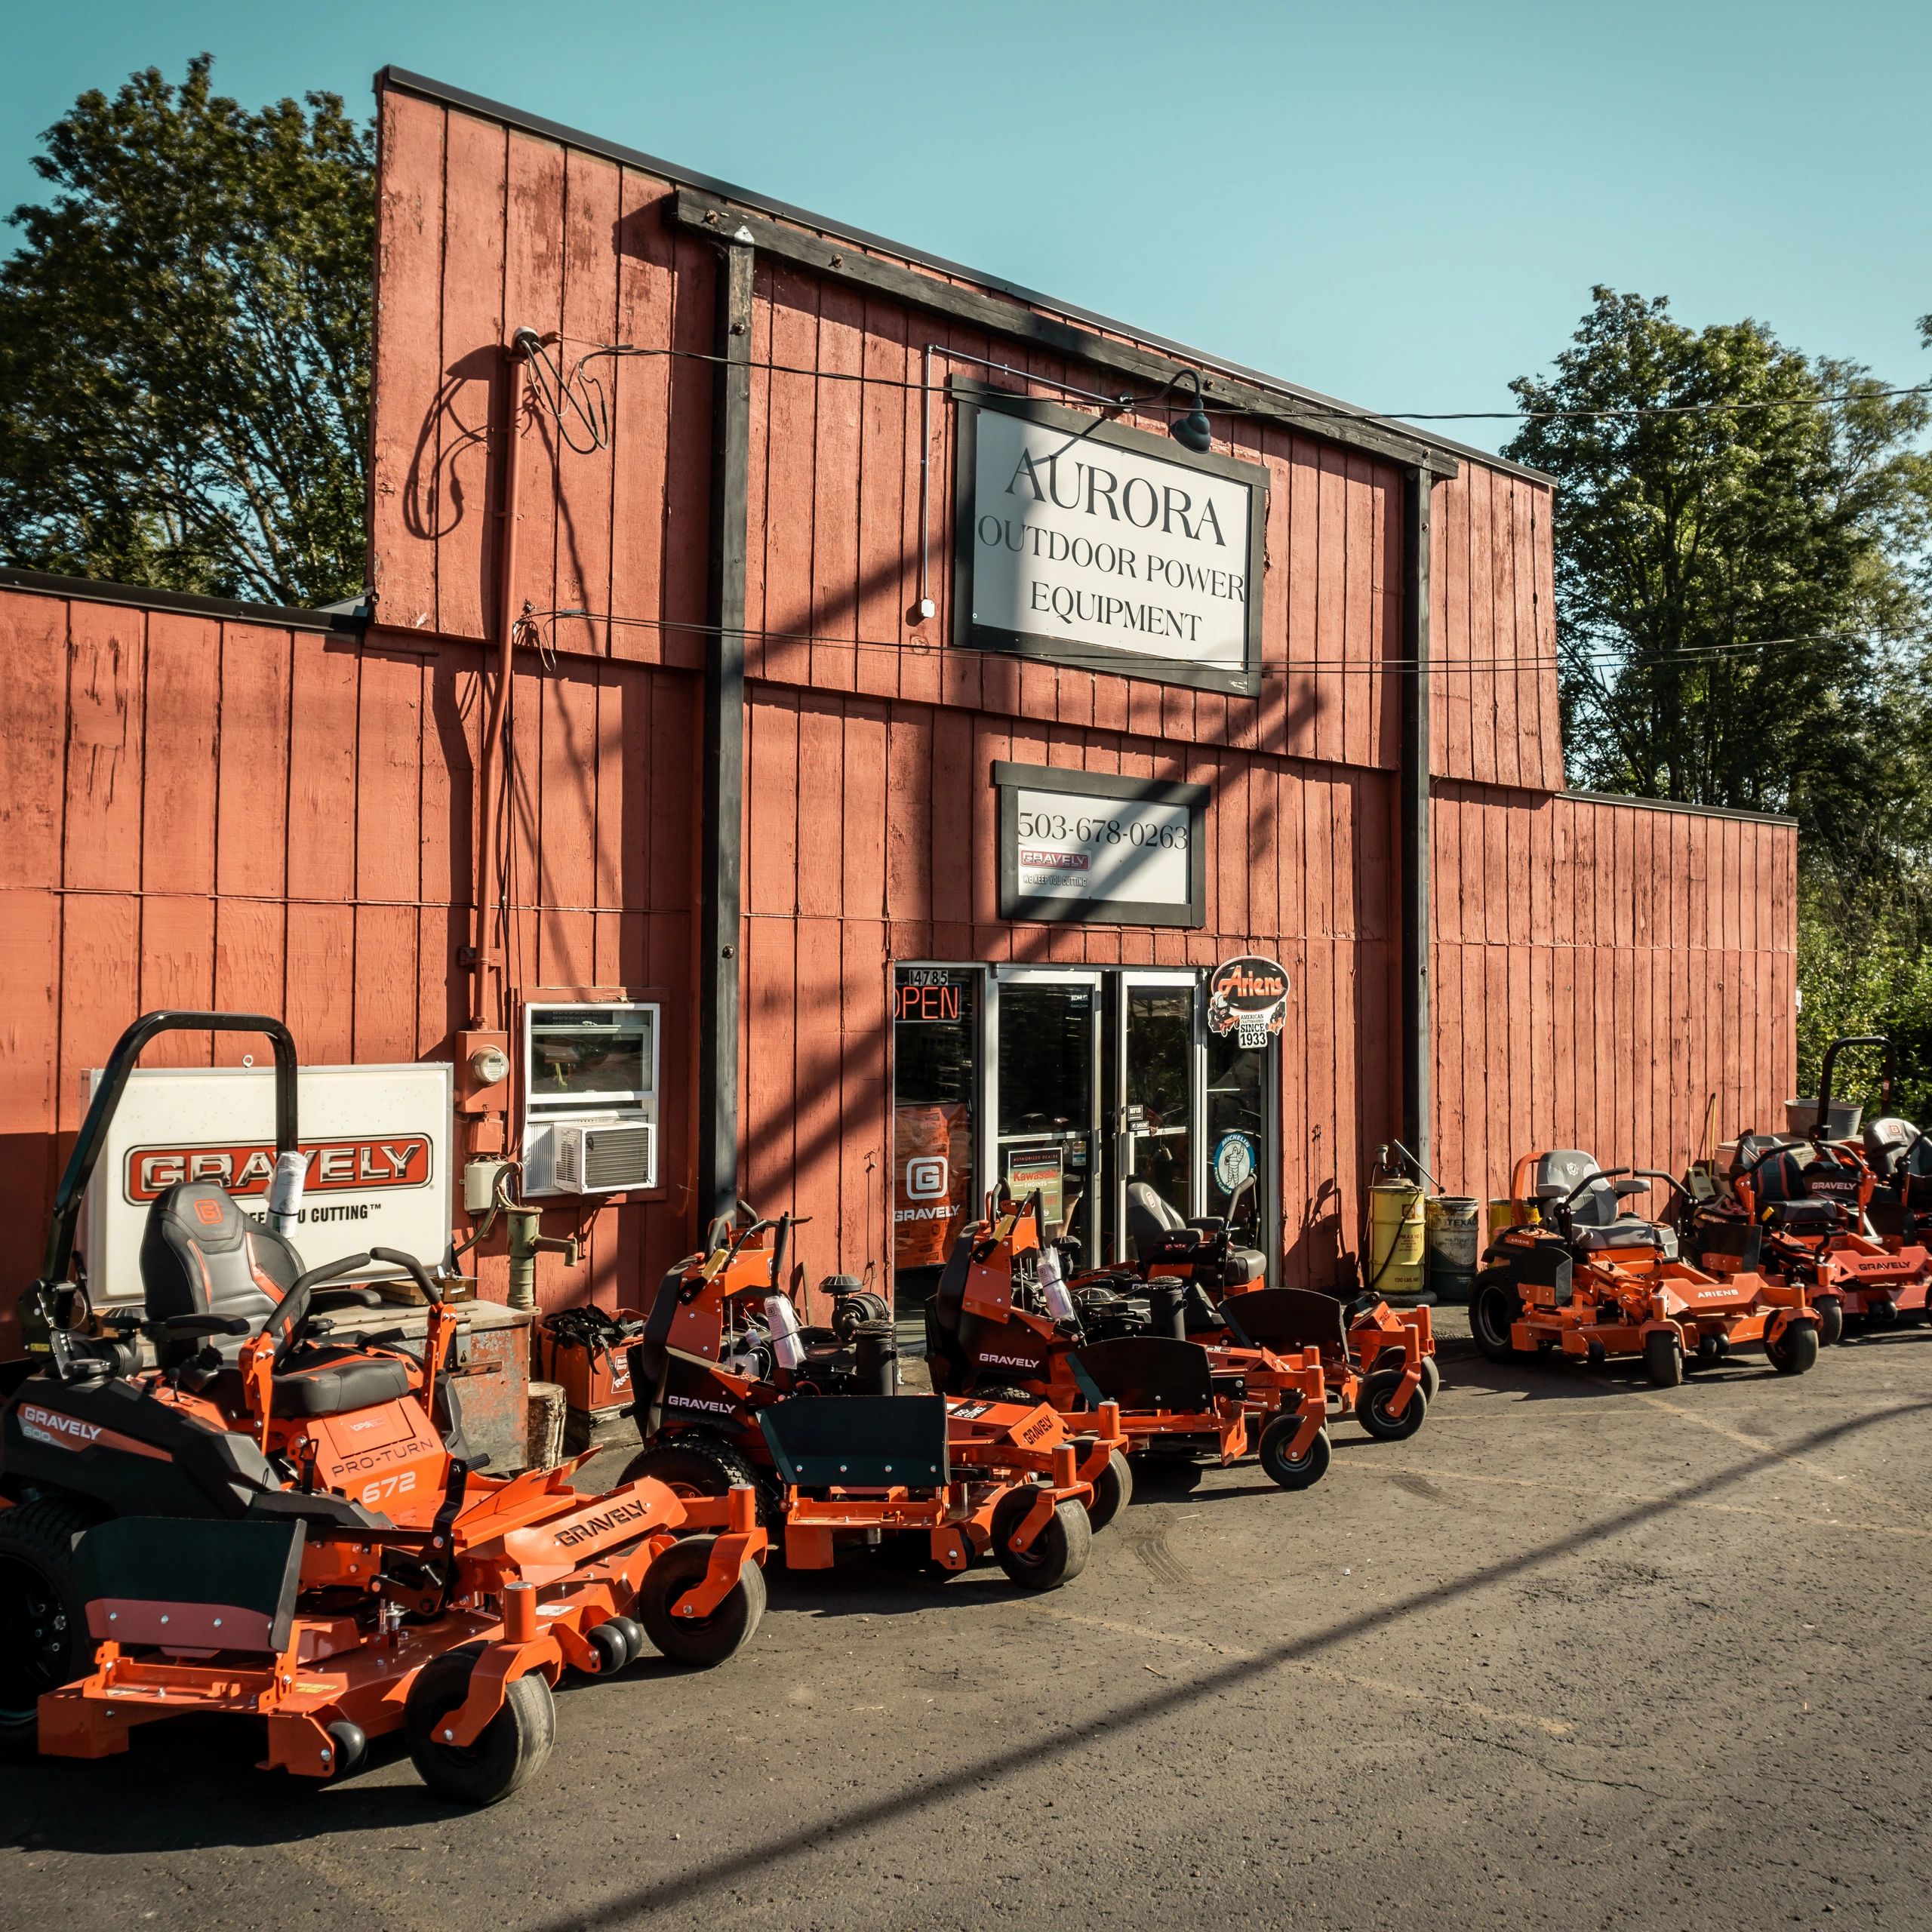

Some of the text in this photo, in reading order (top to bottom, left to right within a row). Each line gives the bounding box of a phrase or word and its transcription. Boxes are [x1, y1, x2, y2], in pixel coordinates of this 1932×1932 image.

[1004, 447, 1226, 546] AURORA
[978, 515, 1244, 602] OUTDOOR POWER
[1030, 580, 1202, 641] EQUIPMENT
[1019, 812, 1189, 850] 503-678-0263
[1023, 852, 1087, 867] GRAVELY
[1023, 875, 1087, 887] WE KEEP YOU CUTTING
[910, 971, 948, 986] 14785
[1218, 965, 1283, 997] Ariens
[1240, 1023, 1266, 1033] SINCE
[1240, 1033, 1266, 1046] 1933
[1221, 1134, 1251, 1148] MICHELIN
[1014, 1169, 1058, 1182] Kawasaki
[1811, 1182, 1857, 1190] GRAVELY
[894, 1204, 961, 1223] GRAVELY
[1858, 1261, 1911, 1271] GRAVELY
[1698, 1289, 1739, 1299] ARIENS
[979, 1352, 1040, 1368] GRAVELY
[668, 1395, 737, 1414] GRAVELY
[24, 1407, 103, 1441] GRAVELY
[1023, 1414, 1054, 1445] GRAVELY
[23, 1426, 51, 1441] 600
[331, 1438, 434, 1478] PRO-TURN
[362, 1471, 416, 1504] 672
[554, 1500, 648, 1547] GRAVELY
